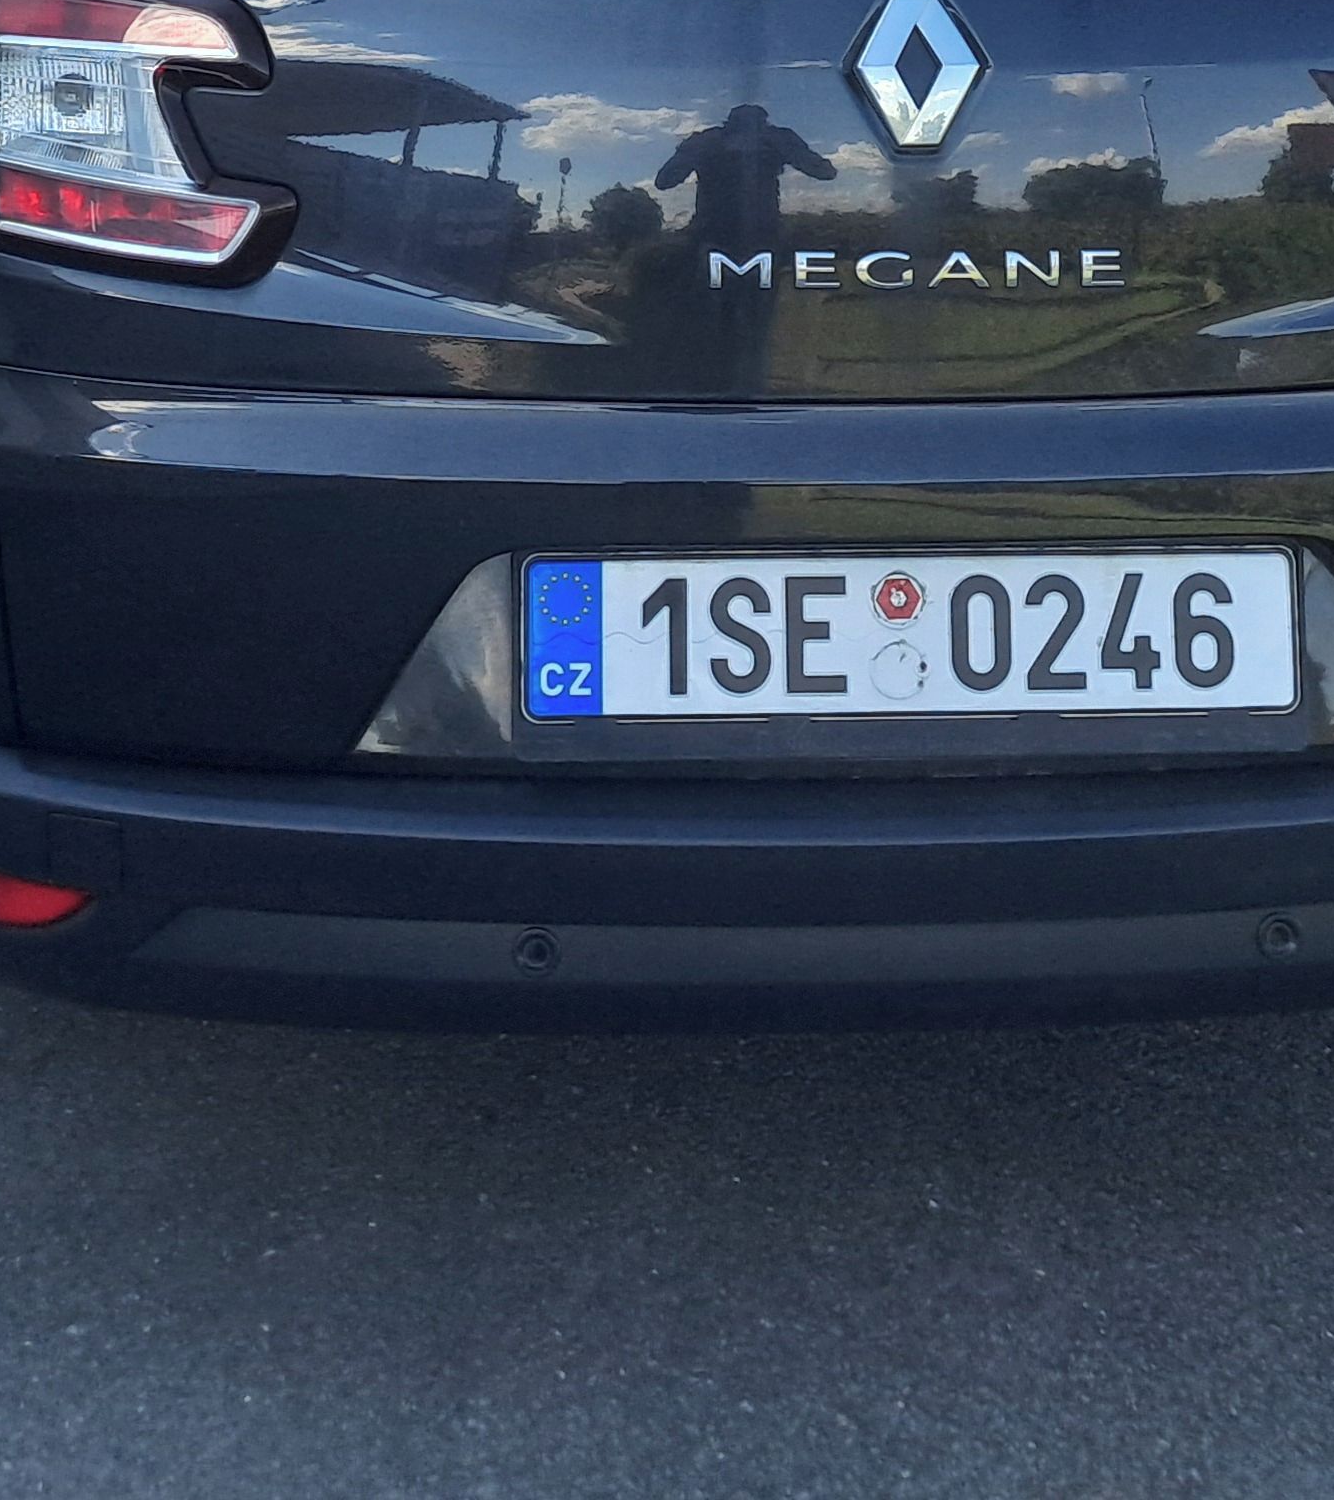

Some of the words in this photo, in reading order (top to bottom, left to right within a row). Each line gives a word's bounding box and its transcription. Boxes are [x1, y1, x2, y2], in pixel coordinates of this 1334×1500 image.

[707, 249, 1126, 290] MEGANE
[641, 574, 848, 695] 1SE
[950, 572, 1235, 692] 0246
[539, 662, 593, 696] CZ
